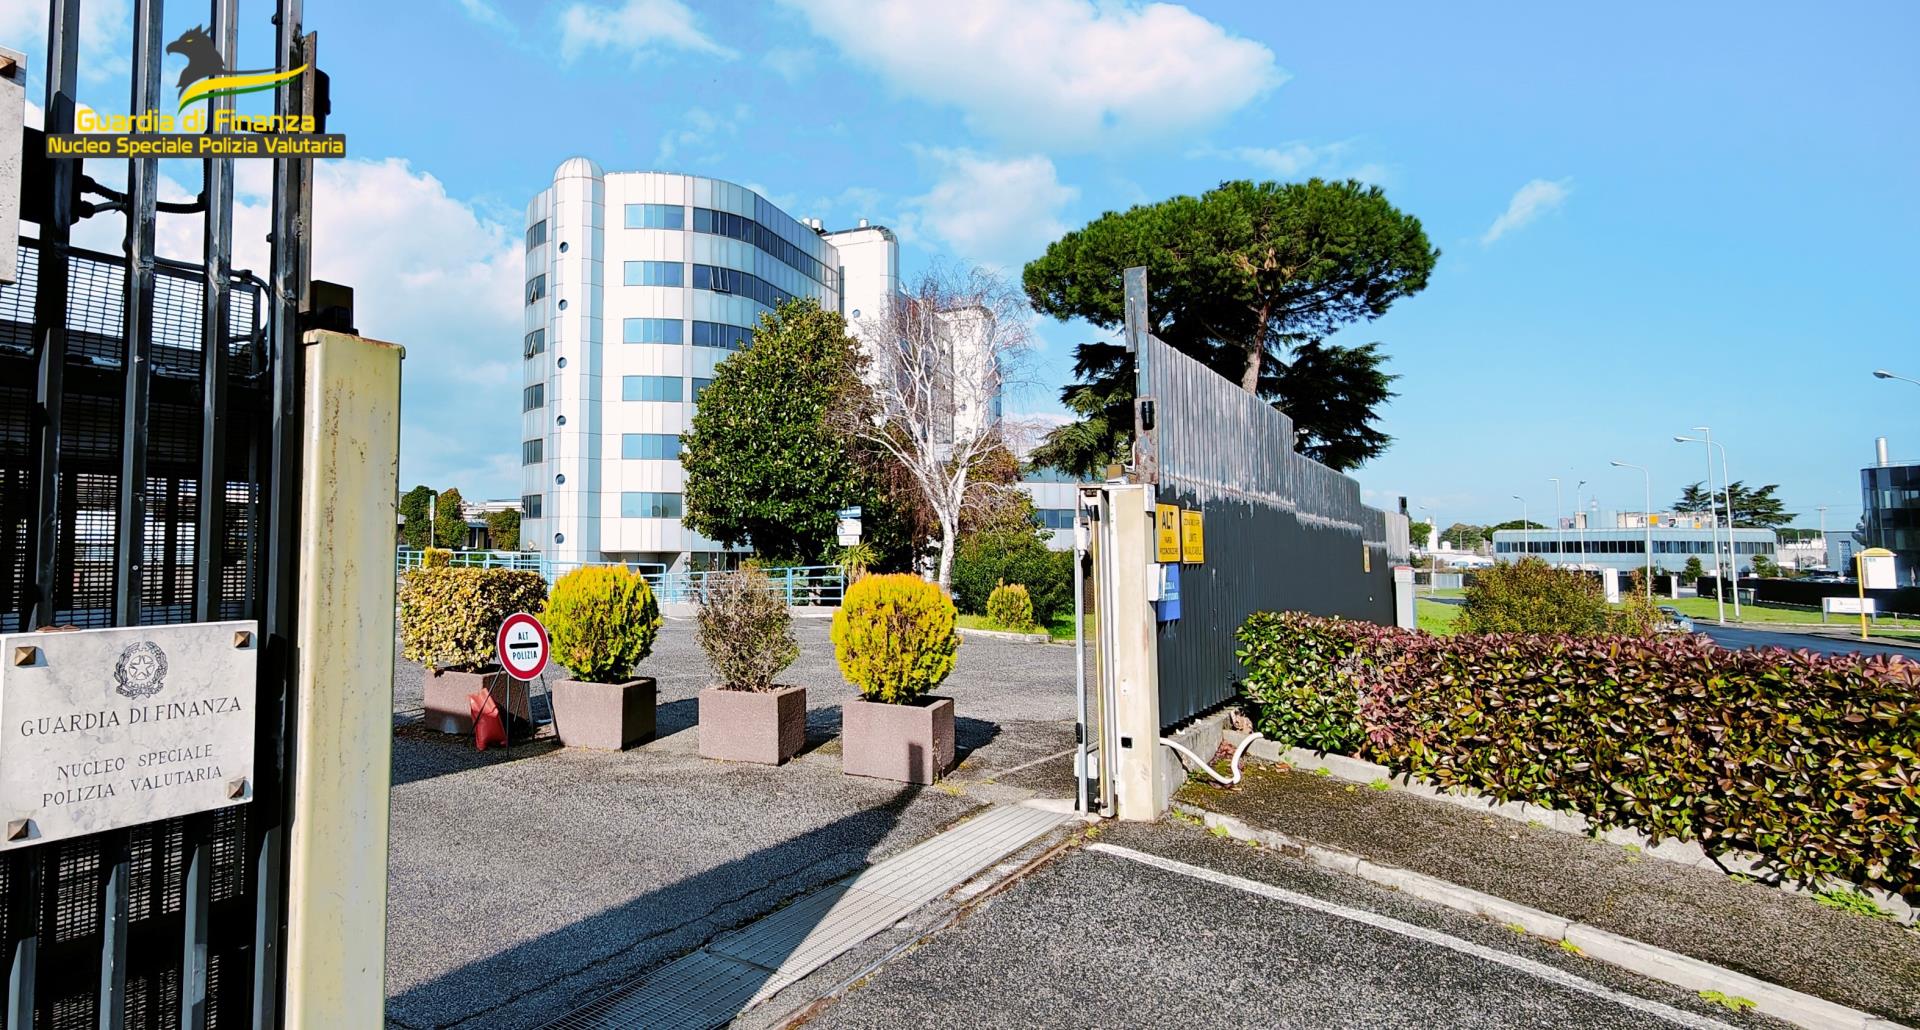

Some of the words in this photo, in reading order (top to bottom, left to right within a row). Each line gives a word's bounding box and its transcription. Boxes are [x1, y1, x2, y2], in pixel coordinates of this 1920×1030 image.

[1162, 511, 1174, 530] ALT
[518, 632, 529, 640] ALT
[512, 650, 537, 660] POLIZIA
[21, 710, 121, 737] GUARDIA
[129, 707, 149, 725] DI
[155, 696, 242, 722] FINANZA
[57, 757, 126, 781] NUCLEO
[138, 744, 213, 768] SPECIALE
[42, 782, 116, 808] POLIZIA
[130, 765, 223, 792] VALUTARIA
